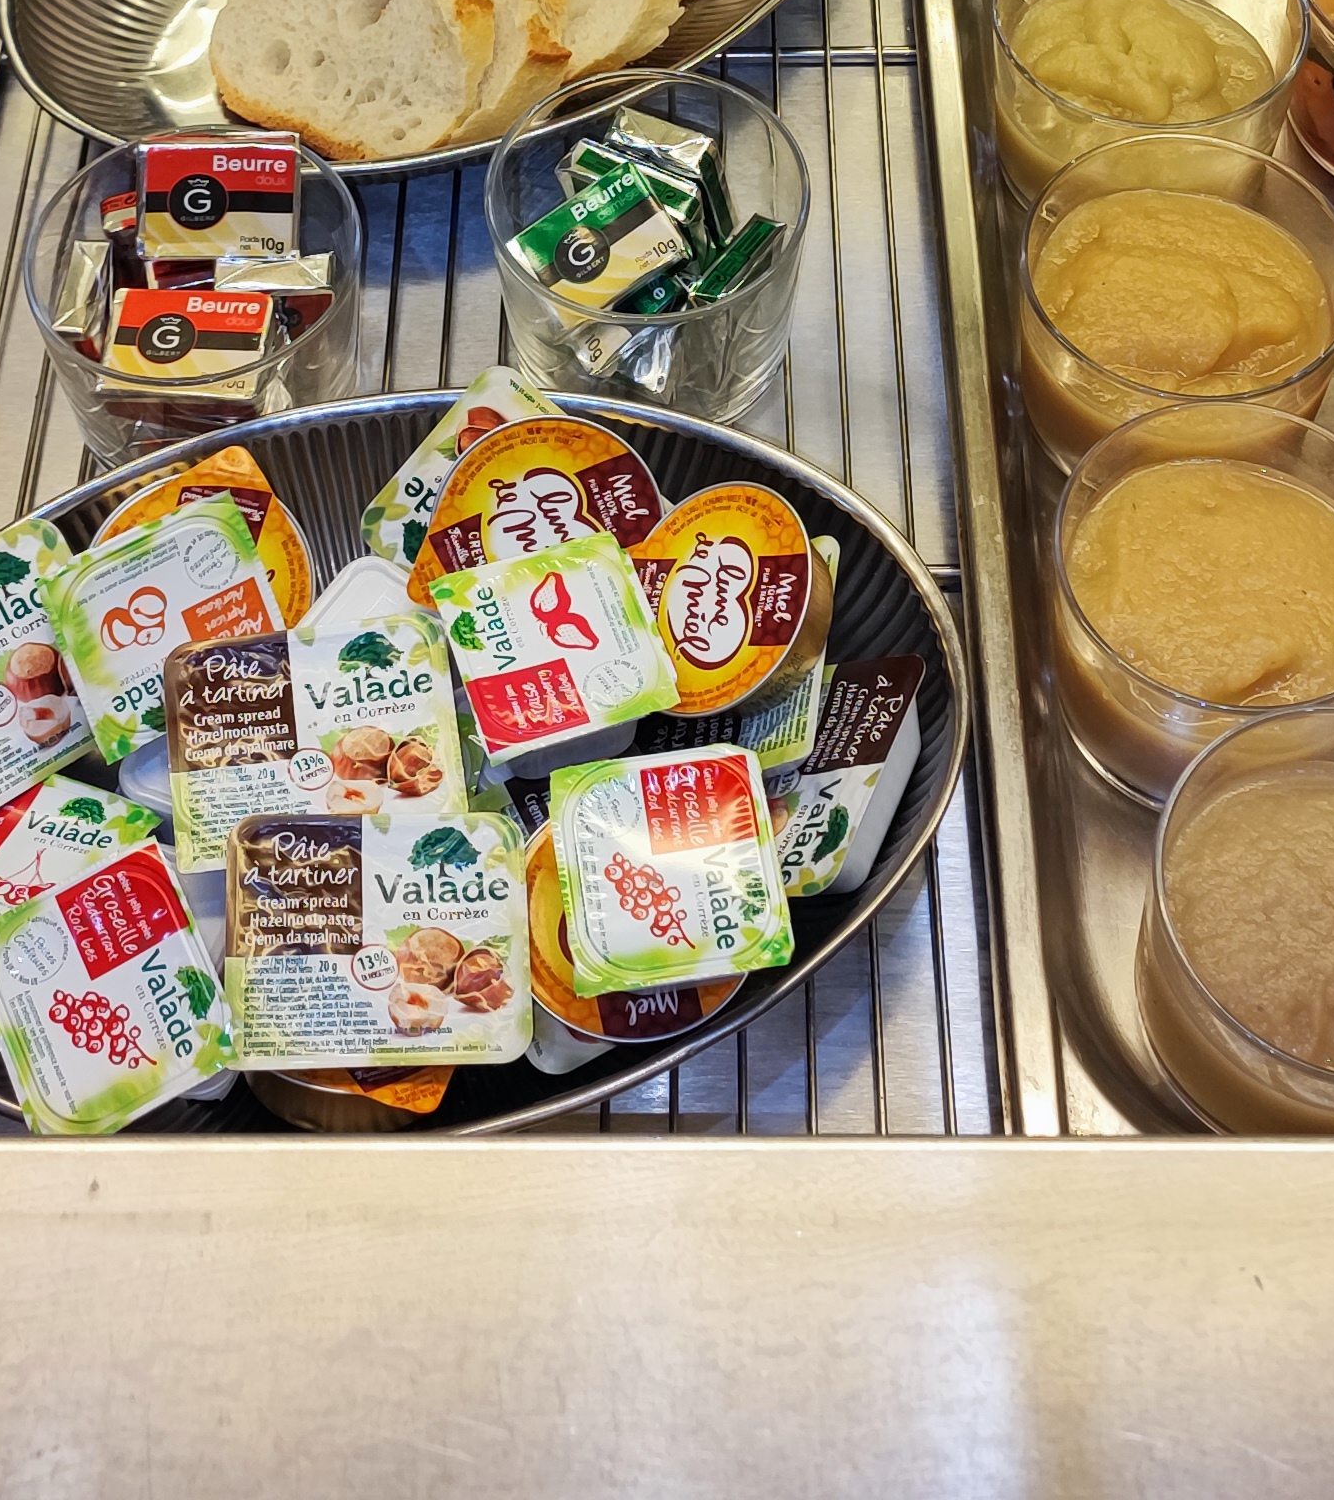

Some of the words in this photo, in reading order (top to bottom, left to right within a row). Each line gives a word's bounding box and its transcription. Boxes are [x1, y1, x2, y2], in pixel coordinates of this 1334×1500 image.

[212, 155, 288, 173] Beurre
[183, 188, 212, 214] G
[569, 172, 637, 223] Beurre
[260, 237, 284, 254] 10g
[567, 238, 596, 267] G
[652, 237, 678, 259] 10g
[186, 297, 261, 315] Beurre
[151, 324, 182, 350] G
[604, 468, 651, 526] Miel
[687, 530, 716, 562] de
[701, 553, 752, 636] lune
[770, 572, 801, 624] Miel
[471, 583, 519, 673] Valade
[202, 654, 262, 682] Pâte
[197, 679, 290, 702] tartiner
[304, 664, 434, 711] Valade
[829, 680, 847, 716] Crema
[192, 710, 235, 727] Cream
[237, 707, 282, 727] spread
[847, 688, 869, 723] Cream
[870, 693, 904, 744] Pâte
[187, 722, 289, 742] Hazelnootpasta
[831, 724, 853, 761] spread
[843, 695, 886, 765] tartiner
[185, 745, 224, 763] Crema
[241, 737, 295, 758] spalmare
[678, 763, 711, 848] Groseille
[24, 809, 114, 850] Valade
[271, 832, 331, 861] Pâte
[244, 859, 260, 885] à
[268, 865, 358, 886] tartiner
[373, 871, 510, 904] Valade
[88, 870, 147, 958] Groseille
[257, 895, 300, 909] Cream
[300, 894, 348, 911] spread
[701, 845, 742, 951] Valade
[250, 911, 355, 929] Hazelnootpasta
[402, 909, 421, 921] en
[63, 902, 92, 936] Rod
[78, 935, 105, 964] bes
[245, 931, 284, 947] Crema
[286, 930, 302, 944] da
[303, 929, 360, 945] spalmare
[132, 948, 205, 1060] Valade
[626, 989, 679, 1026] Miel
[139, 1000, 173, 1052] Corrèze
